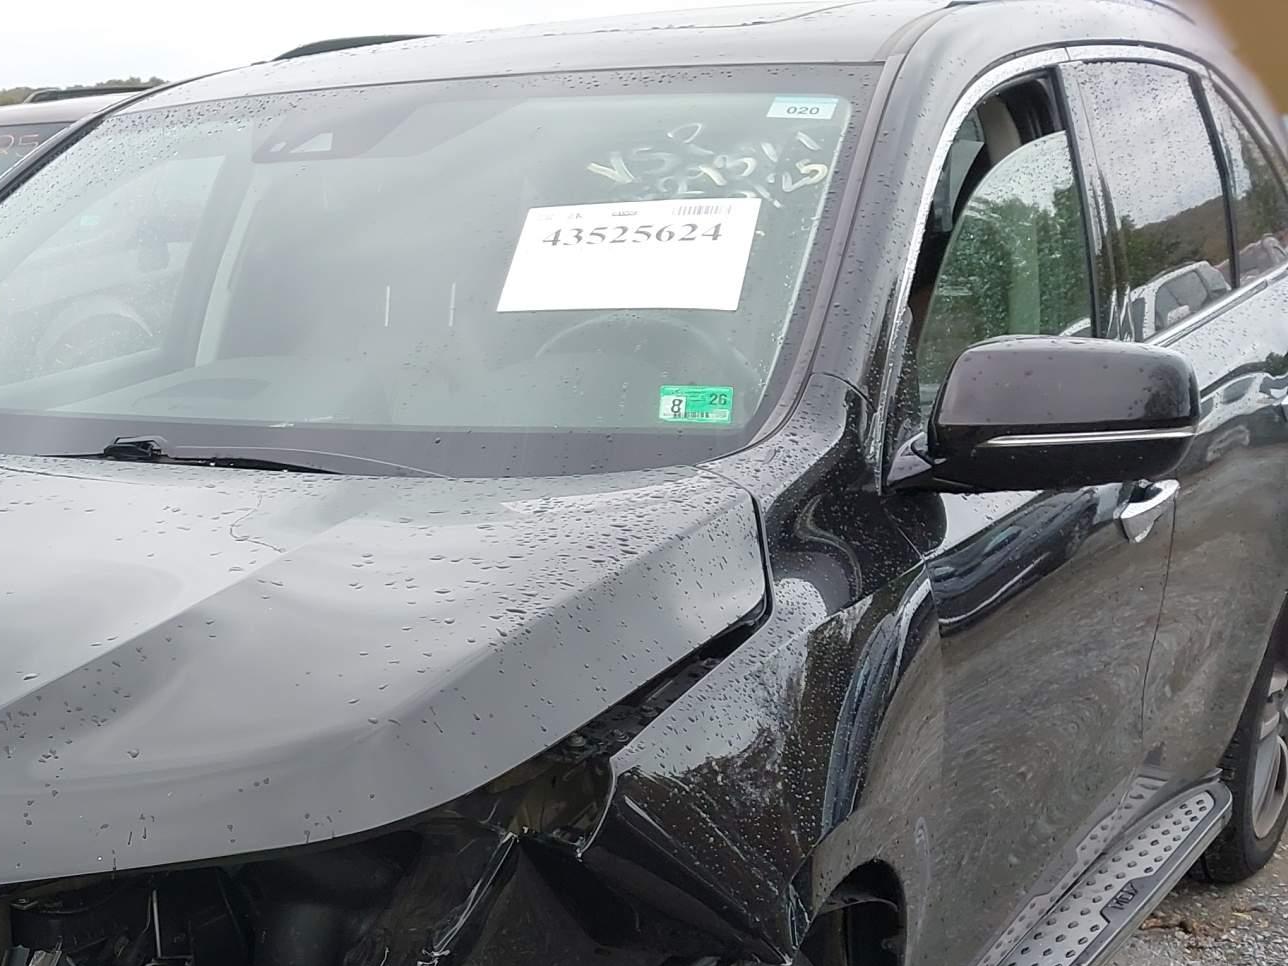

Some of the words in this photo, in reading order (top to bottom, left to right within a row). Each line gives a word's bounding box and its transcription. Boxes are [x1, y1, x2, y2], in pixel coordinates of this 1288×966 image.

[786, 106, 820, 115] 020
[541, 222, 723, 247] 43525624
[670, 398, 683, 414] 8
[708, 393, 728, 406] 26
